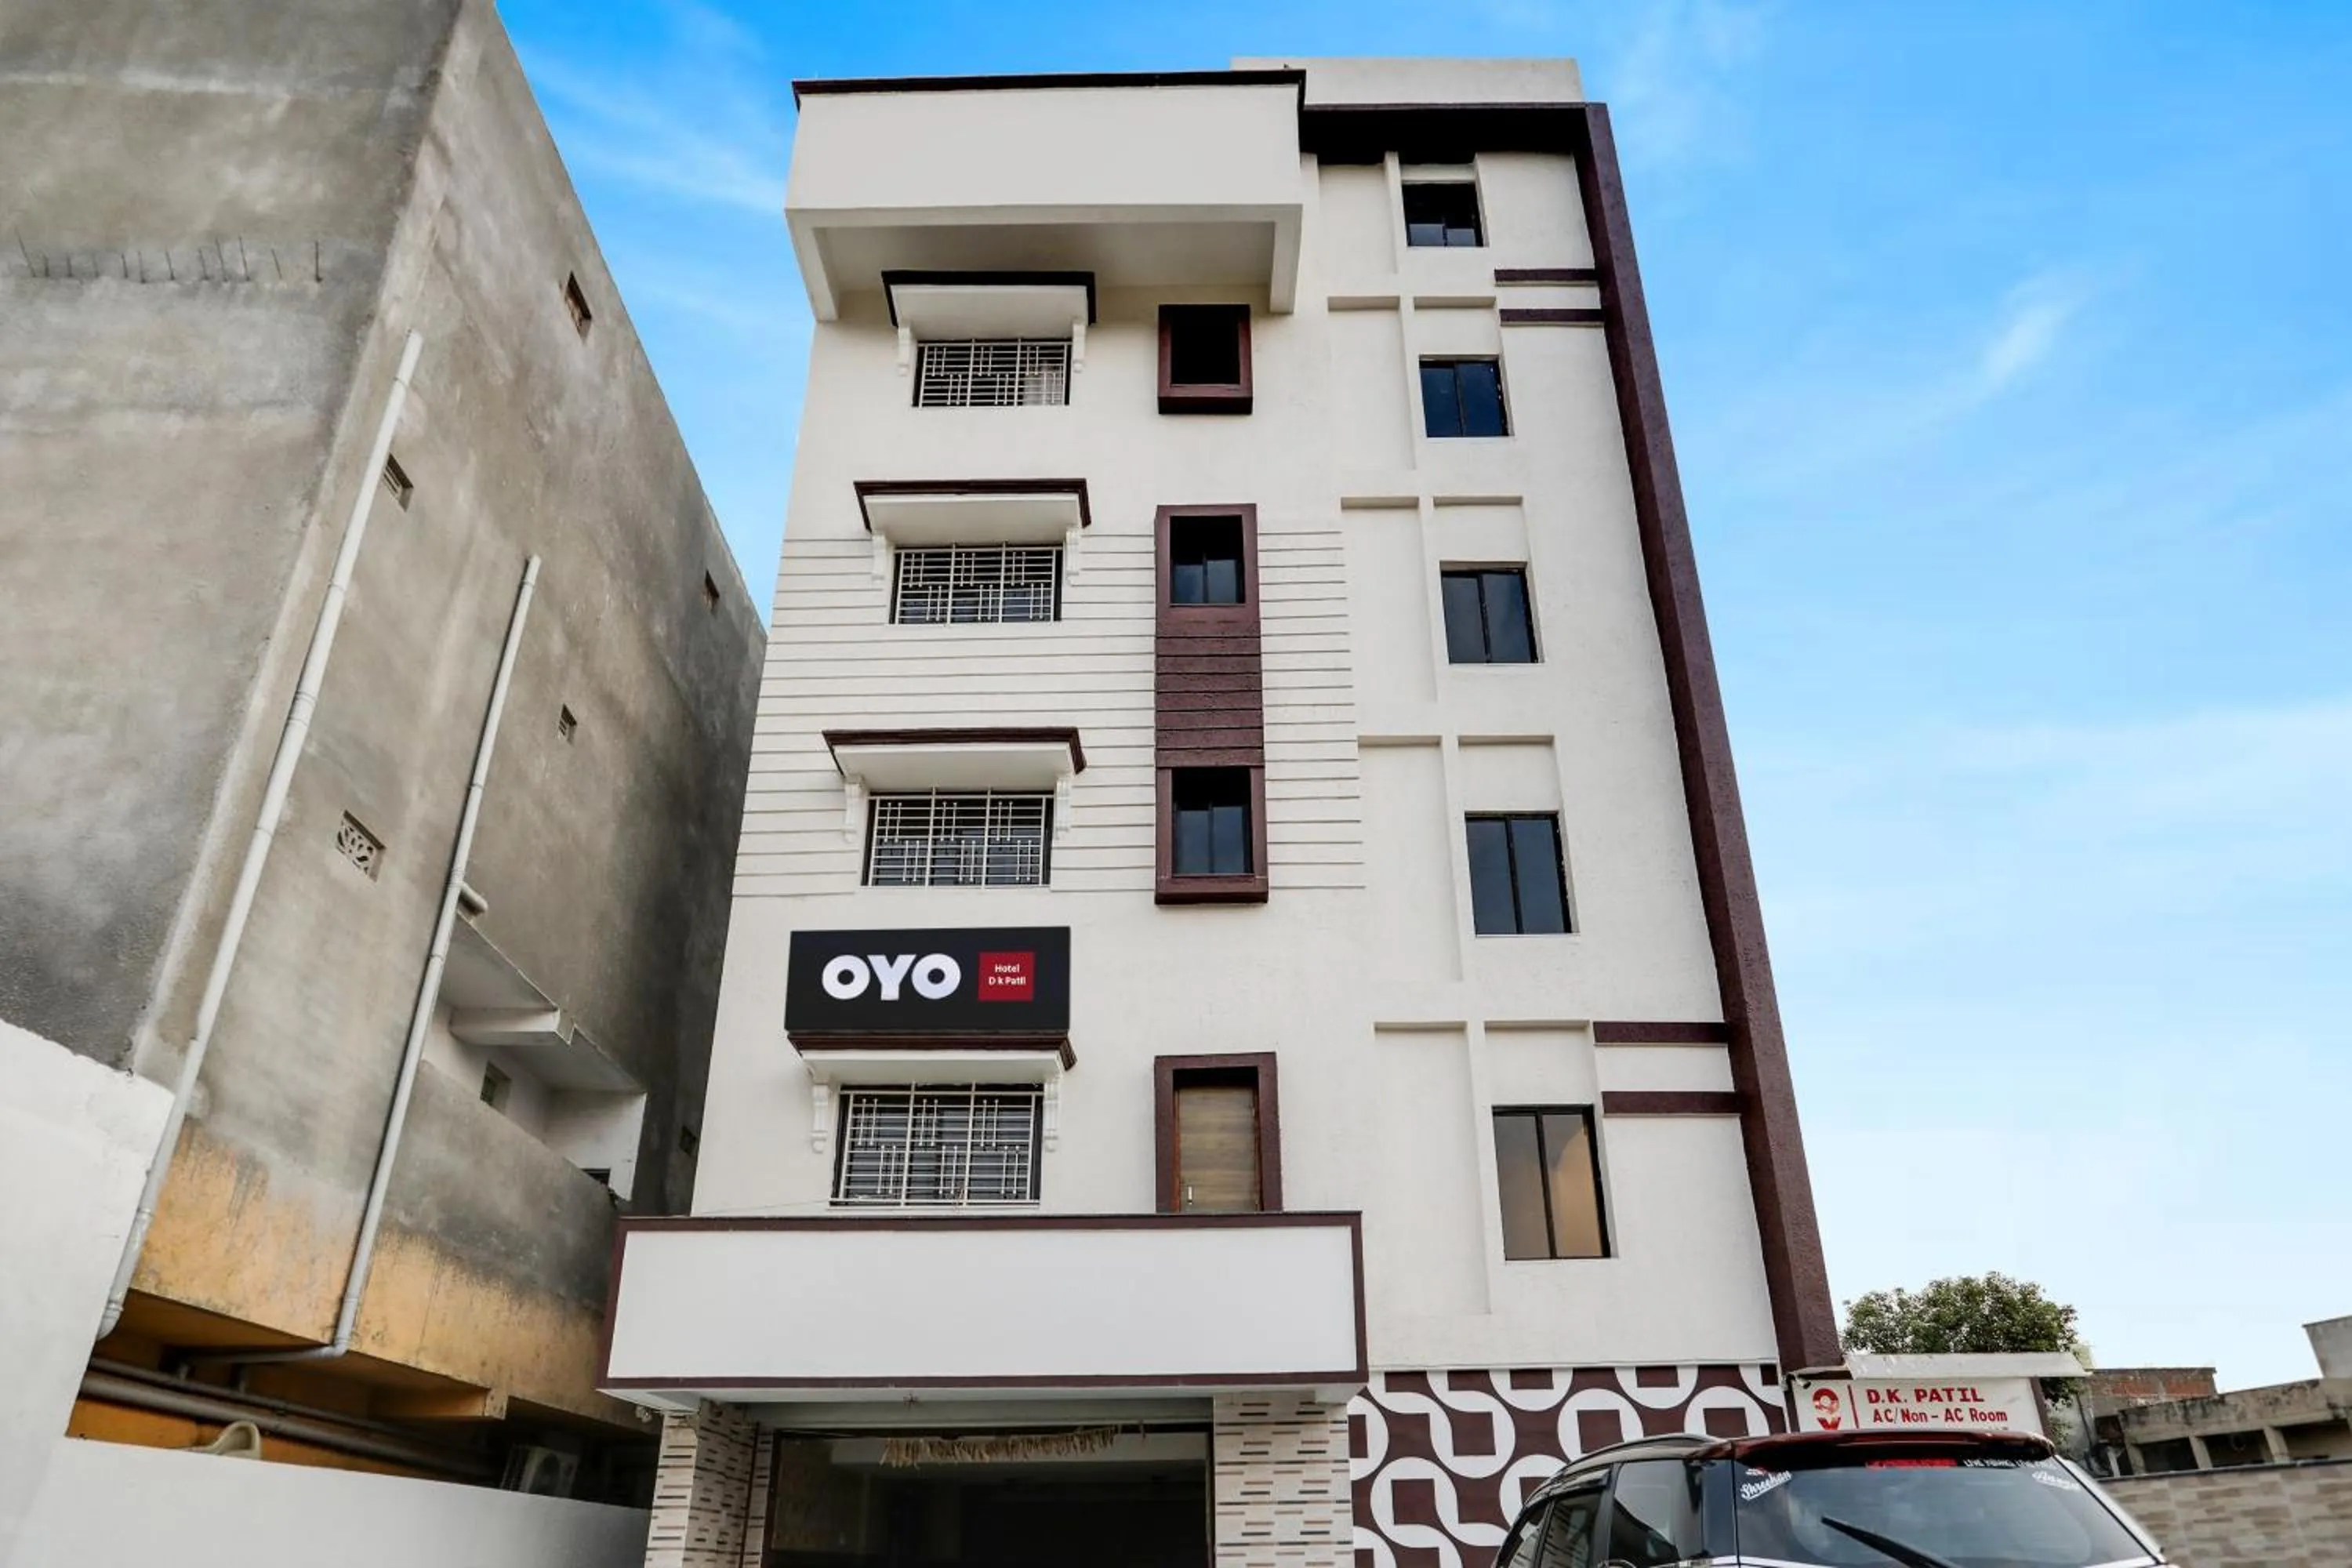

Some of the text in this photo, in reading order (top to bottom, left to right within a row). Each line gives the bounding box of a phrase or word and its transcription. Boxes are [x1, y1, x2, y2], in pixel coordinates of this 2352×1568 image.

[994, 963, 1020, 973] Hotel
[822, 953, 961, 1001] OYO
[989, 976, 996, 985] D
[1005, 976, 1026, 985] Patil
[1866, 1387, 1985, 1403] D.K. PATIL
[1944, 1408, 1964, 1422] AC
[1969, 1407, 2008, 1422] Room
